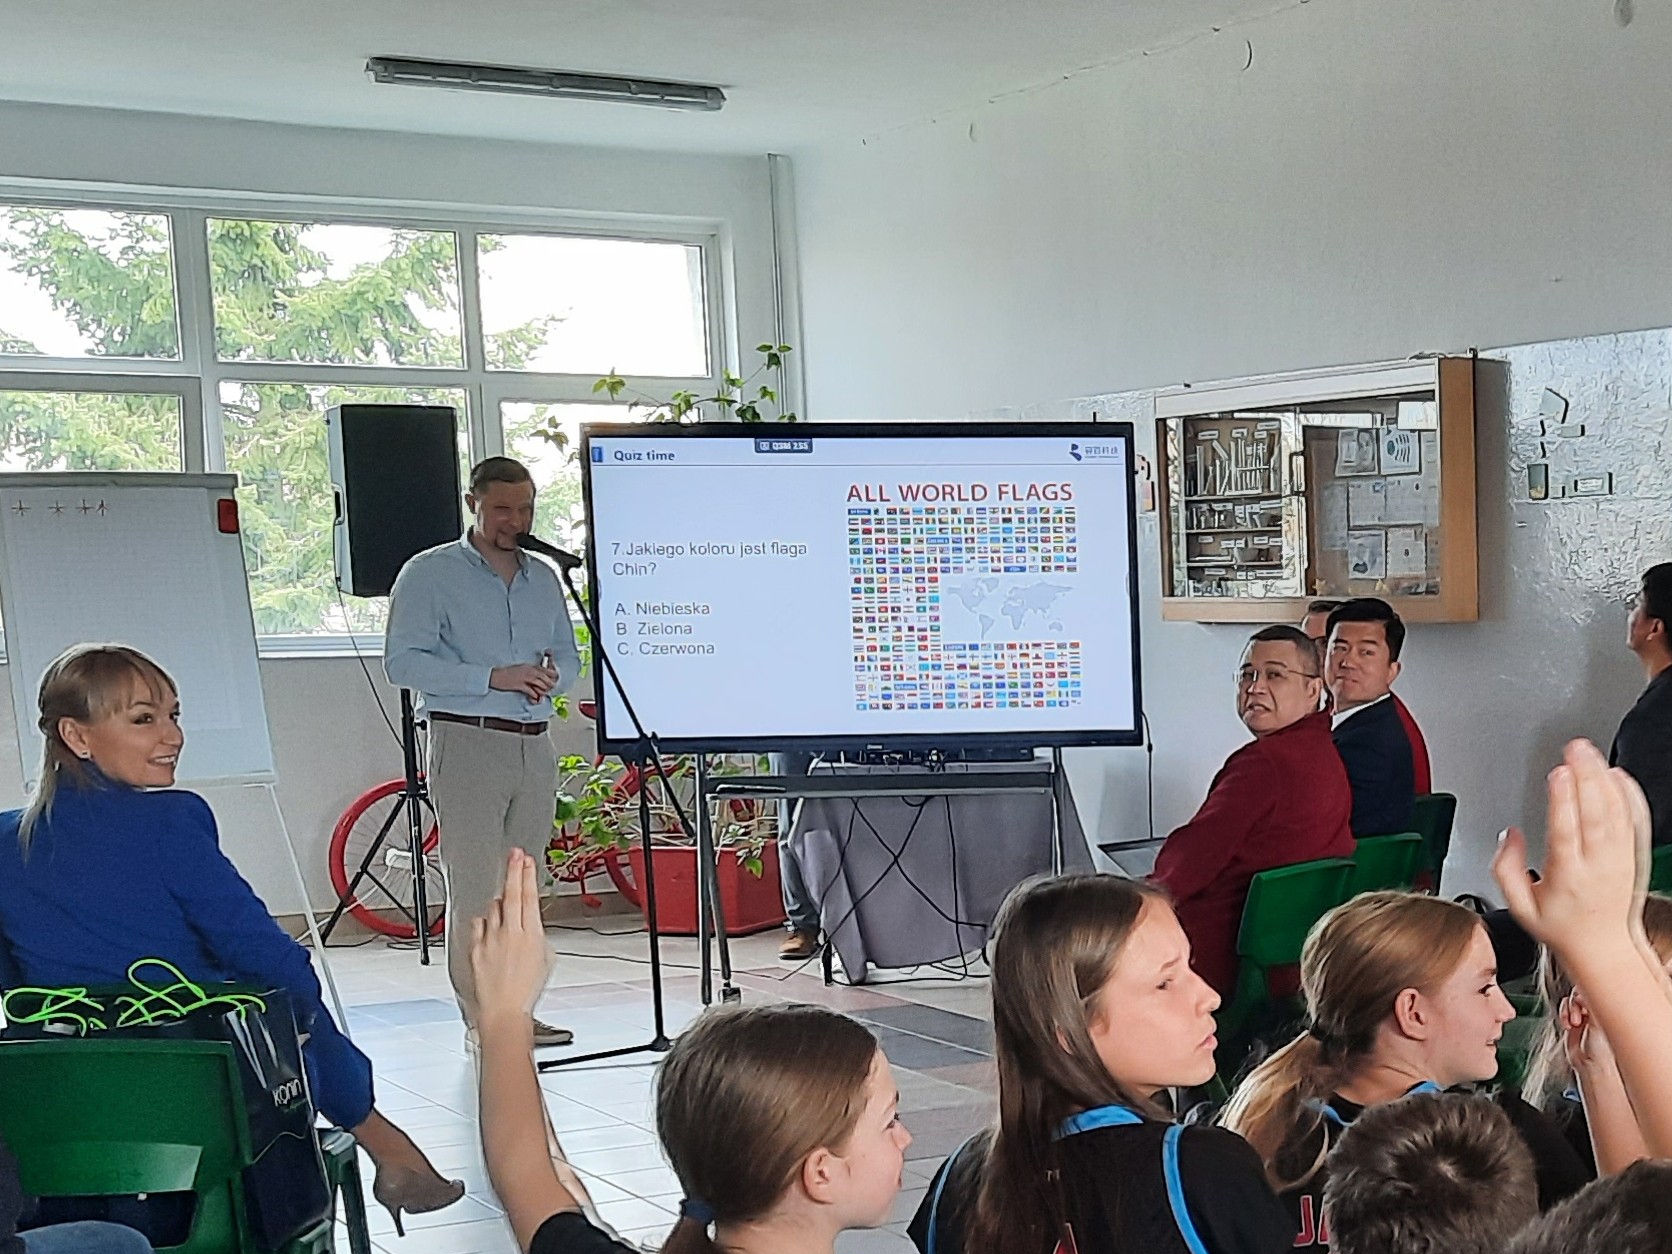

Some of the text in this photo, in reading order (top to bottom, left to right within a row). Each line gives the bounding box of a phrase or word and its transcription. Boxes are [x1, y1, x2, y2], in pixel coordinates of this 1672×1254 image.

[614, 449, 675, 462] Quiz time
[847, 483, 1073, 502] ALL WORLD FLAGS
[689, 542, 736, 556] koloru
[739, 542, 767, 558] jest
[770, 542, 808, 558] flaga
[612, 562, 657, 577] Chin?
[614, 602, 711, 617] A. Niebieska
[637, 622, 693, 636] Zielona
[639, 642, 715, 656] Czerwona
